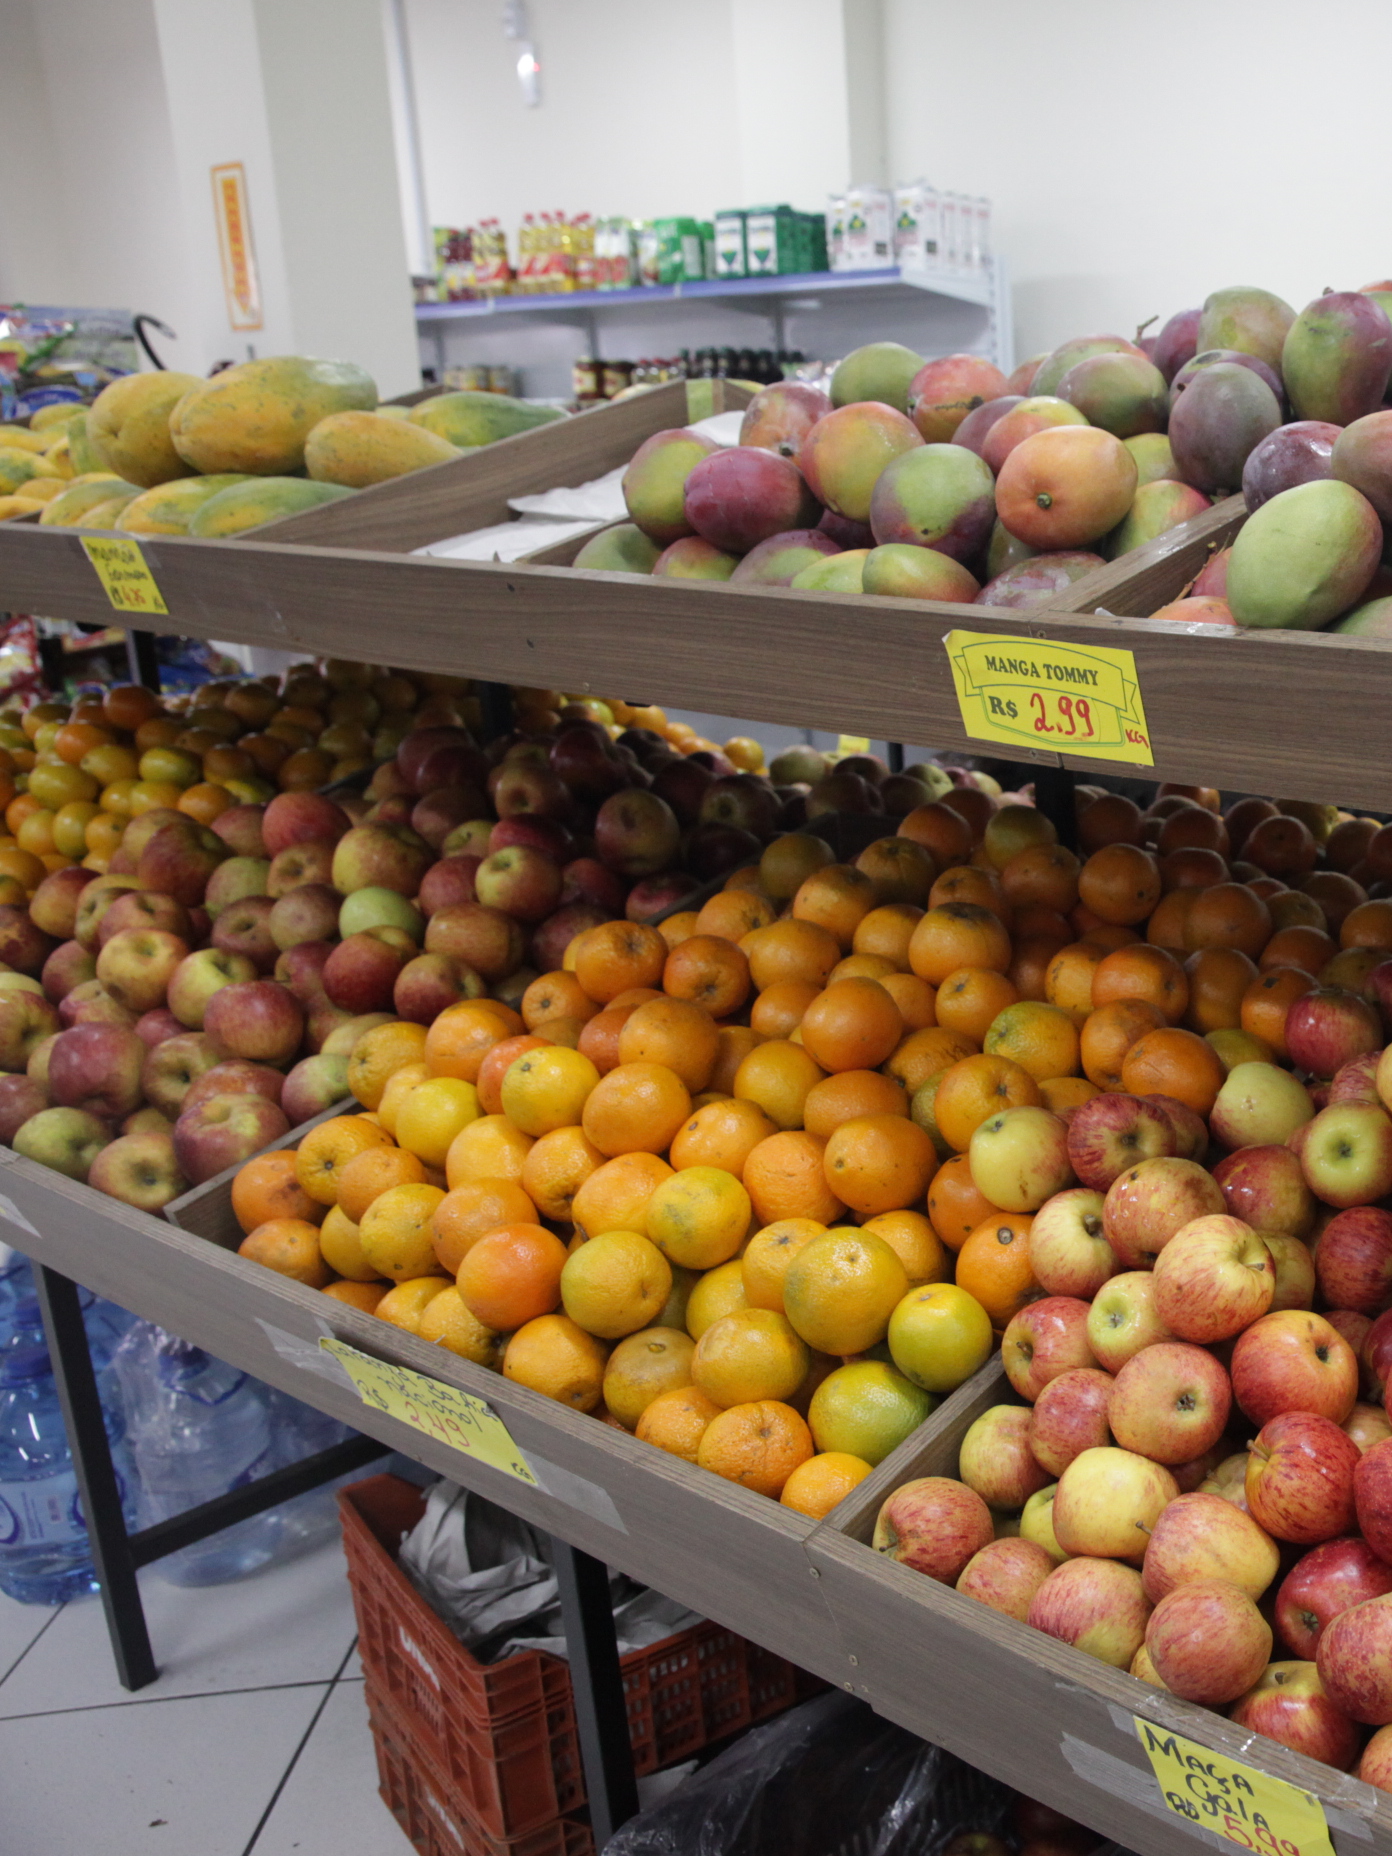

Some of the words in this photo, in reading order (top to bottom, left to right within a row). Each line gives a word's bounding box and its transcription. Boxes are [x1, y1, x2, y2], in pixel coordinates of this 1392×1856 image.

[984, 655, 1041, 678] MANGA
[1043, 663, 1098, 686] TOMMY
[988, 695, 1018, 719] R$
